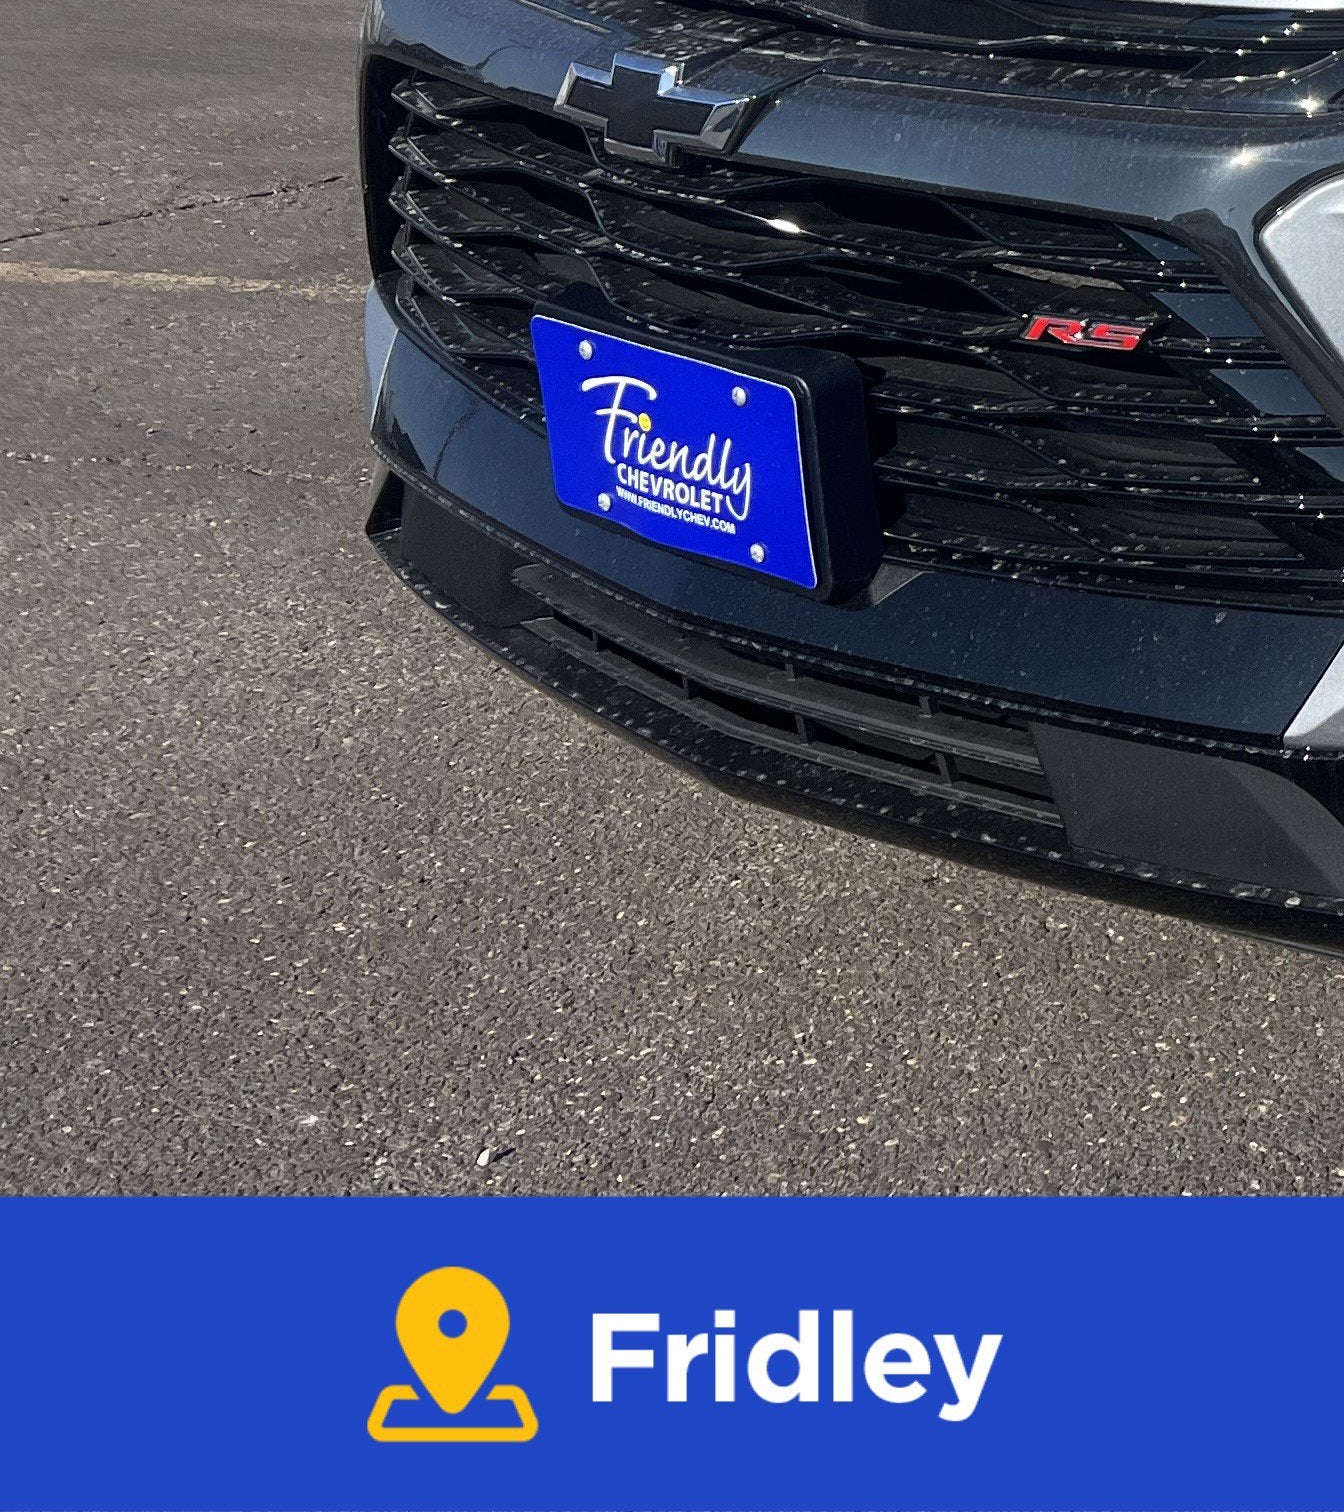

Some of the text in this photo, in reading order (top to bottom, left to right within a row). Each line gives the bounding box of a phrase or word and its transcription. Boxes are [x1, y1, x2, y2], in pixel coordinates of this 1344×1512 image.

[1022, 315, 1147, 351] RS
[581, 375, 752, 521] Friendly
[615, 484, 737, 535] WWW.FRIENDLYCHEV.COM
[616, 462, 724, 515] CHEVROLET
